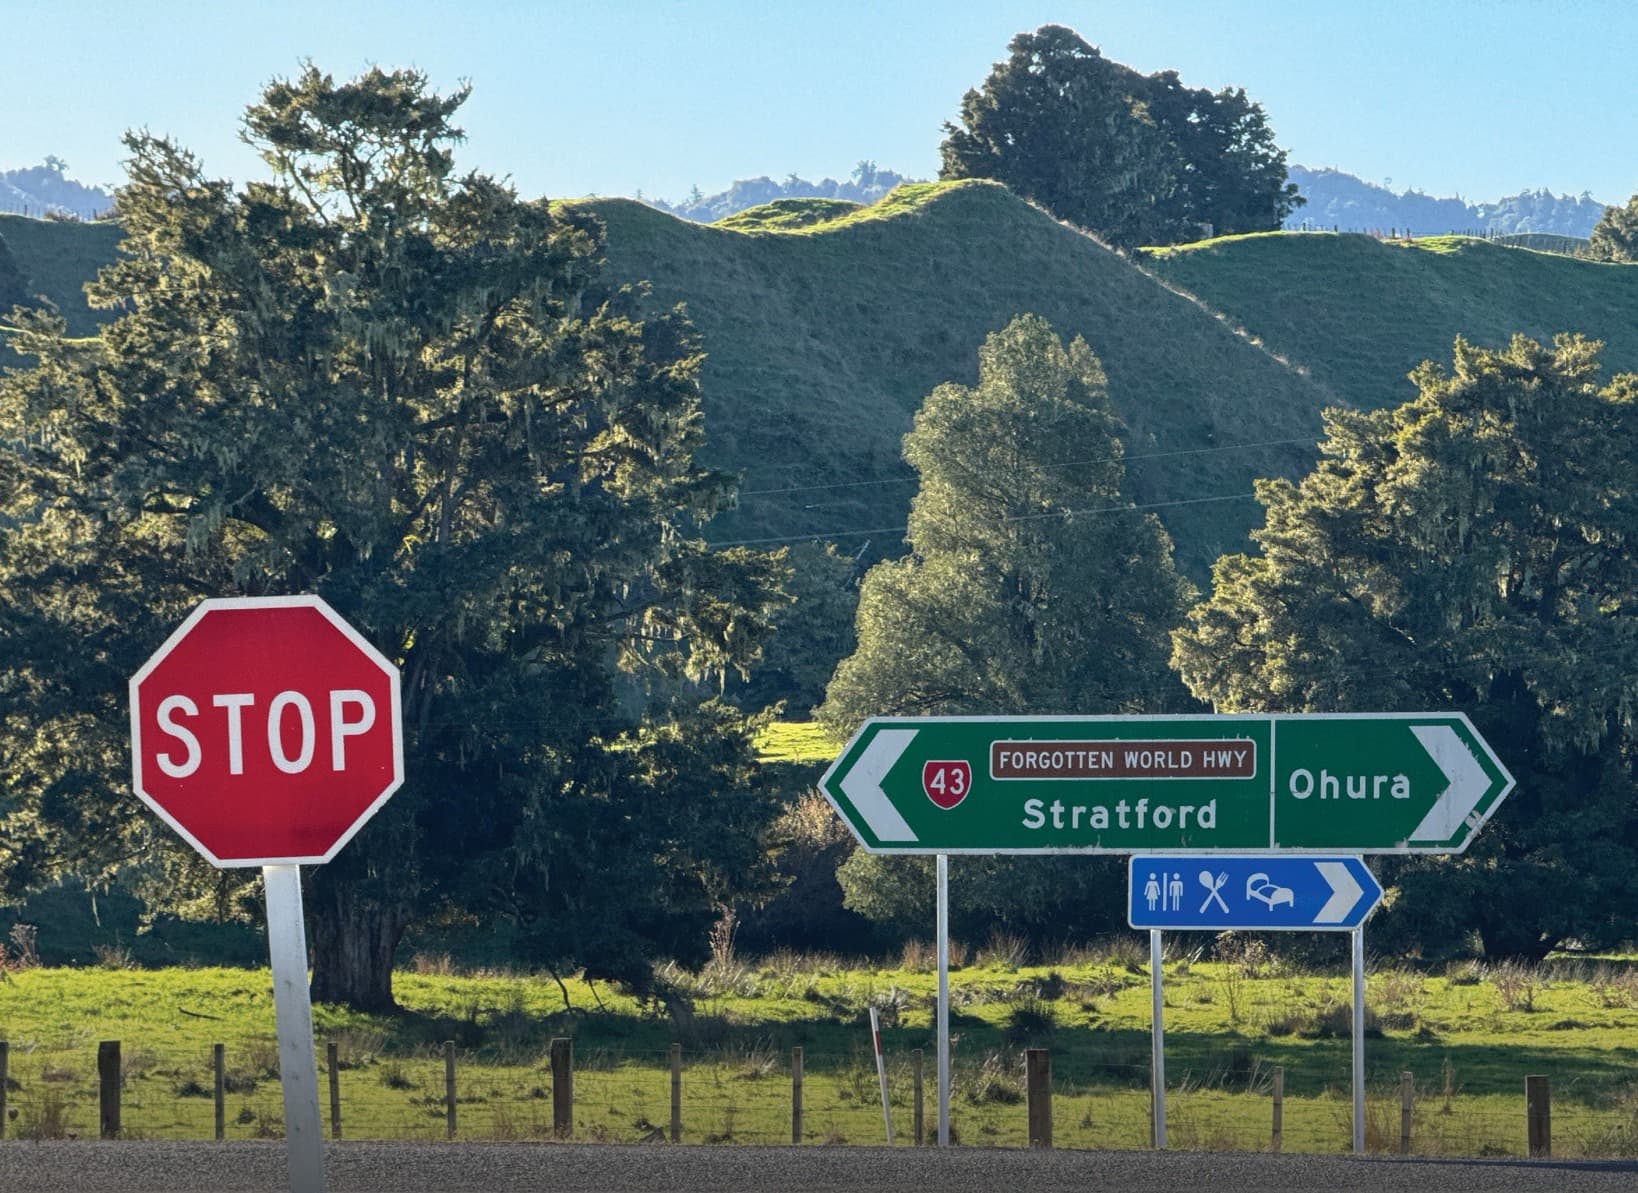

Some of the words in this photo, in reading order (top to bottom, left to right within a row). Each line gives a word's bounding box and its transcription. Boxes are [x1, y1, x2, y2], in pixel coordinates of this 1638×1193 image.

[156, 689, 376, 779] STOP
[999, 751, 1115, 770] FORGOTTEN
[1124, 751, 1193, 769] WORLD
[1202, 750, 1248, 769] HWY
[929, 768, 966, 794] 43
[1289, 768, 1411, 800] Ohura
[1022, 798, 1218, 830] Stratford
